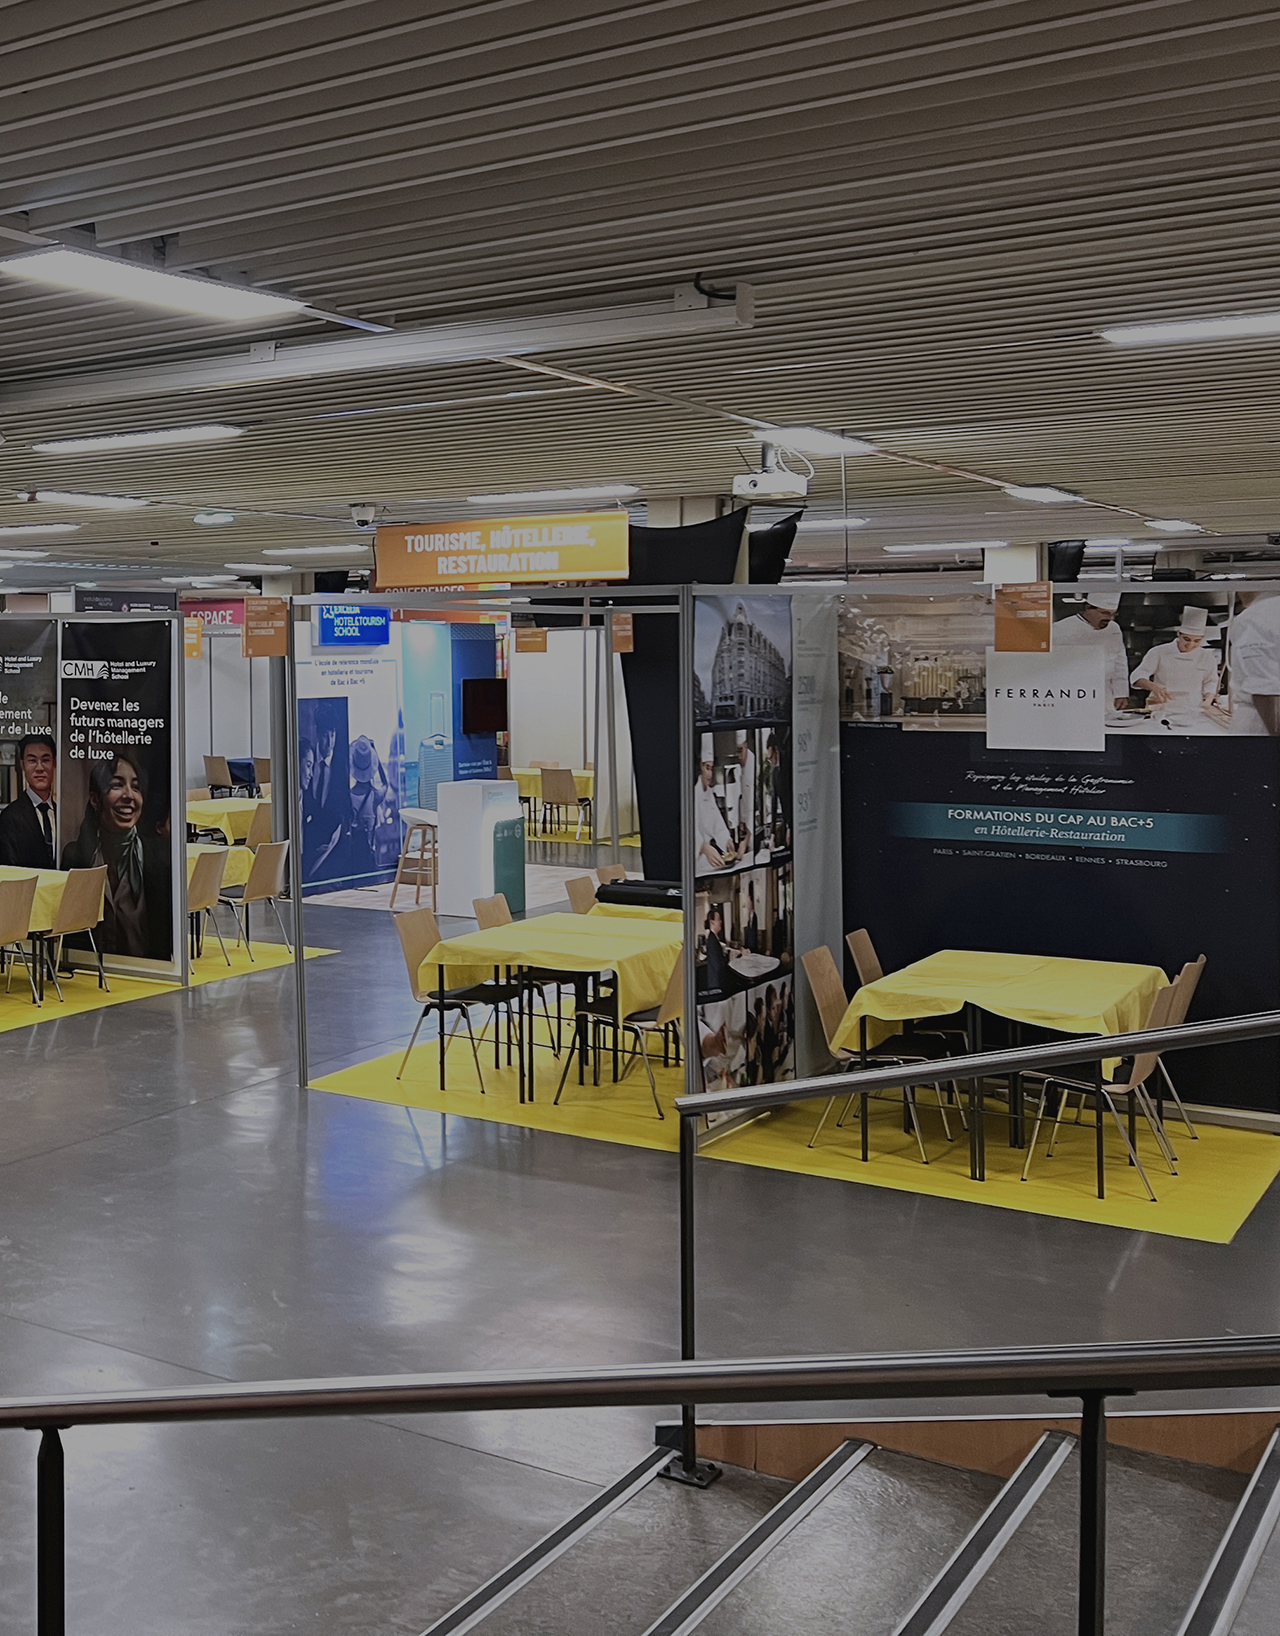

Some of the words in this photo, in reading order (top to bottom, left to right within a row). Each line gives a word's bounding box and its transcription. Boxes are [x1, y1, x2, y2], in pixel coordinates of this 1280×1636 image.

[405, 531, 487, 553] TOURISME,
[490, 525, 596, 549] HÔTELLERIE,
[438, 551, 559, 575] RESTAURATION
[334, 627, 360, 637] SCHOOL
[63, 662, 94, 677] CMH
[994, 688, 1096, 699] FERRANDI
[70, 697, 120, 712] Devenez
[122, 698, 140, 712] les
[8, 722, 22, 735] de
[24, 723, 52, 736] Luxe
[69, 713, 105, 727] futurs
[107, 718, 165, 732] managers
[69, 729, 85, 743] de
[88, 729, 152, 744] l'hôtellerie
[69, 745, 85, 759] de
[88, 745, 114, 760] luxe
[948, 809, 1031, 823] FORMATIONS
[1036, 813, 1054, 824] DU
[1058, 814, 1083, 825] CAP
[1086, 816, 1106, 827] AU
[1111, 816, 1154, 829] BAC+5
[974, 827, 987, 835] en
[990, 825, 1126, 842] Hôtellerie-Restauration
[933, 848, 953, 856] PARIS
[962, 849, 1016, 859] SAINT-GRATIEN
[1025, 853, 1066, 862] BORDEAUX
[1075, 856, 1106, 865] RENNES
[1115, 858, 1168, 868] STRASBOURG
